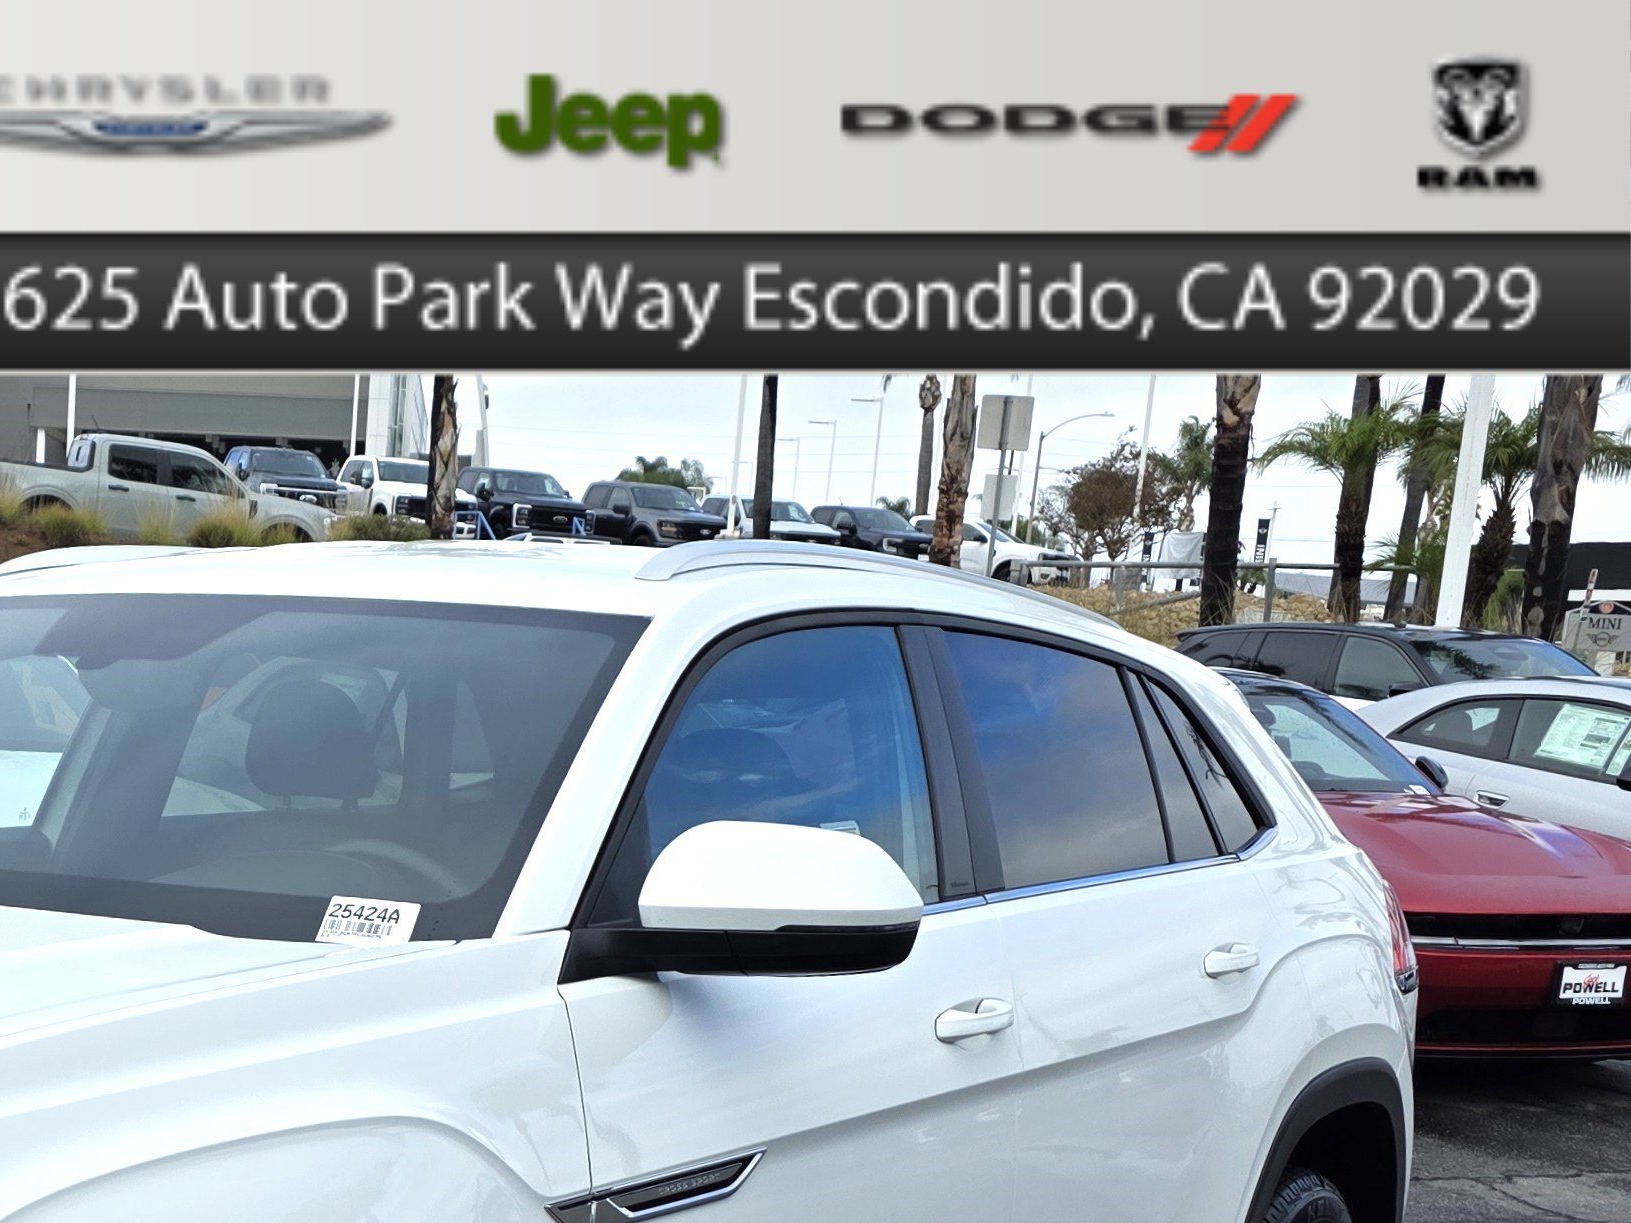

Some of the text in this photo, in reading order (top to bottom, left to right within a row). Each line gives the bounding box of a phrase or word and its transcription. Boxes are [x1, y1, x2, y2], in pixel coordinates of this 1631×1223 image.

[1588, 616, 1623, 630] MINI
[328, 903, 400, 924] 25424A
[1562, 981, 1619, 994] POWELL
[1572, 997, 1611, 1005] POWELL
